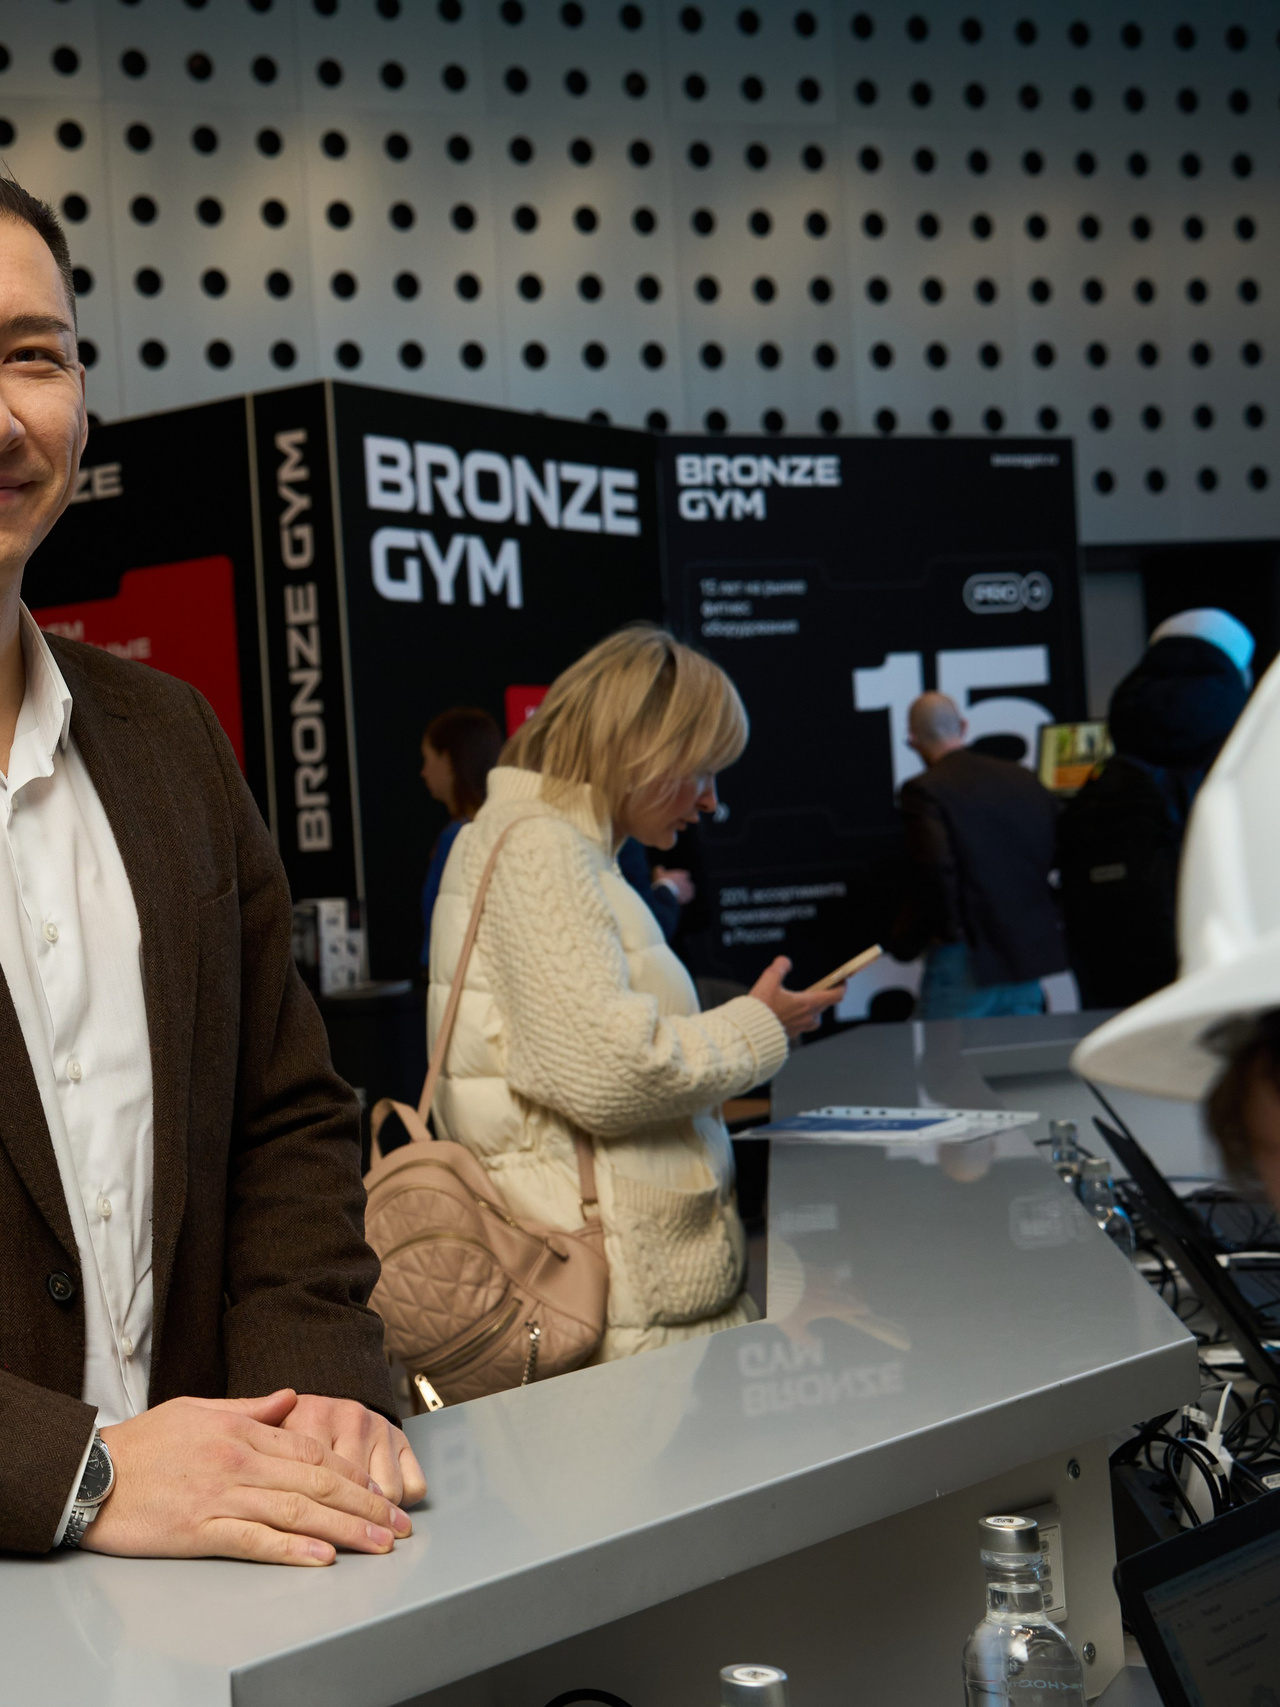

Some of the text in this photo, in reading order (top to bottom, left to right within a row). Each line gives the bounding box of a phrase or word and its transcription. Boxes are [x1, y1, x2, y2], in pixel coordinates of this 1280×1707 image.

[363, 435, 640, 537] BRONZE
[676, 454, 841, 486] BRONZE
[678, 488, 766, 520] GYM
[371, 526, 523, 609] GYM
[275, 429, 332, 852] BRONZE GYM
[853, 644, 1055, 806] 15
